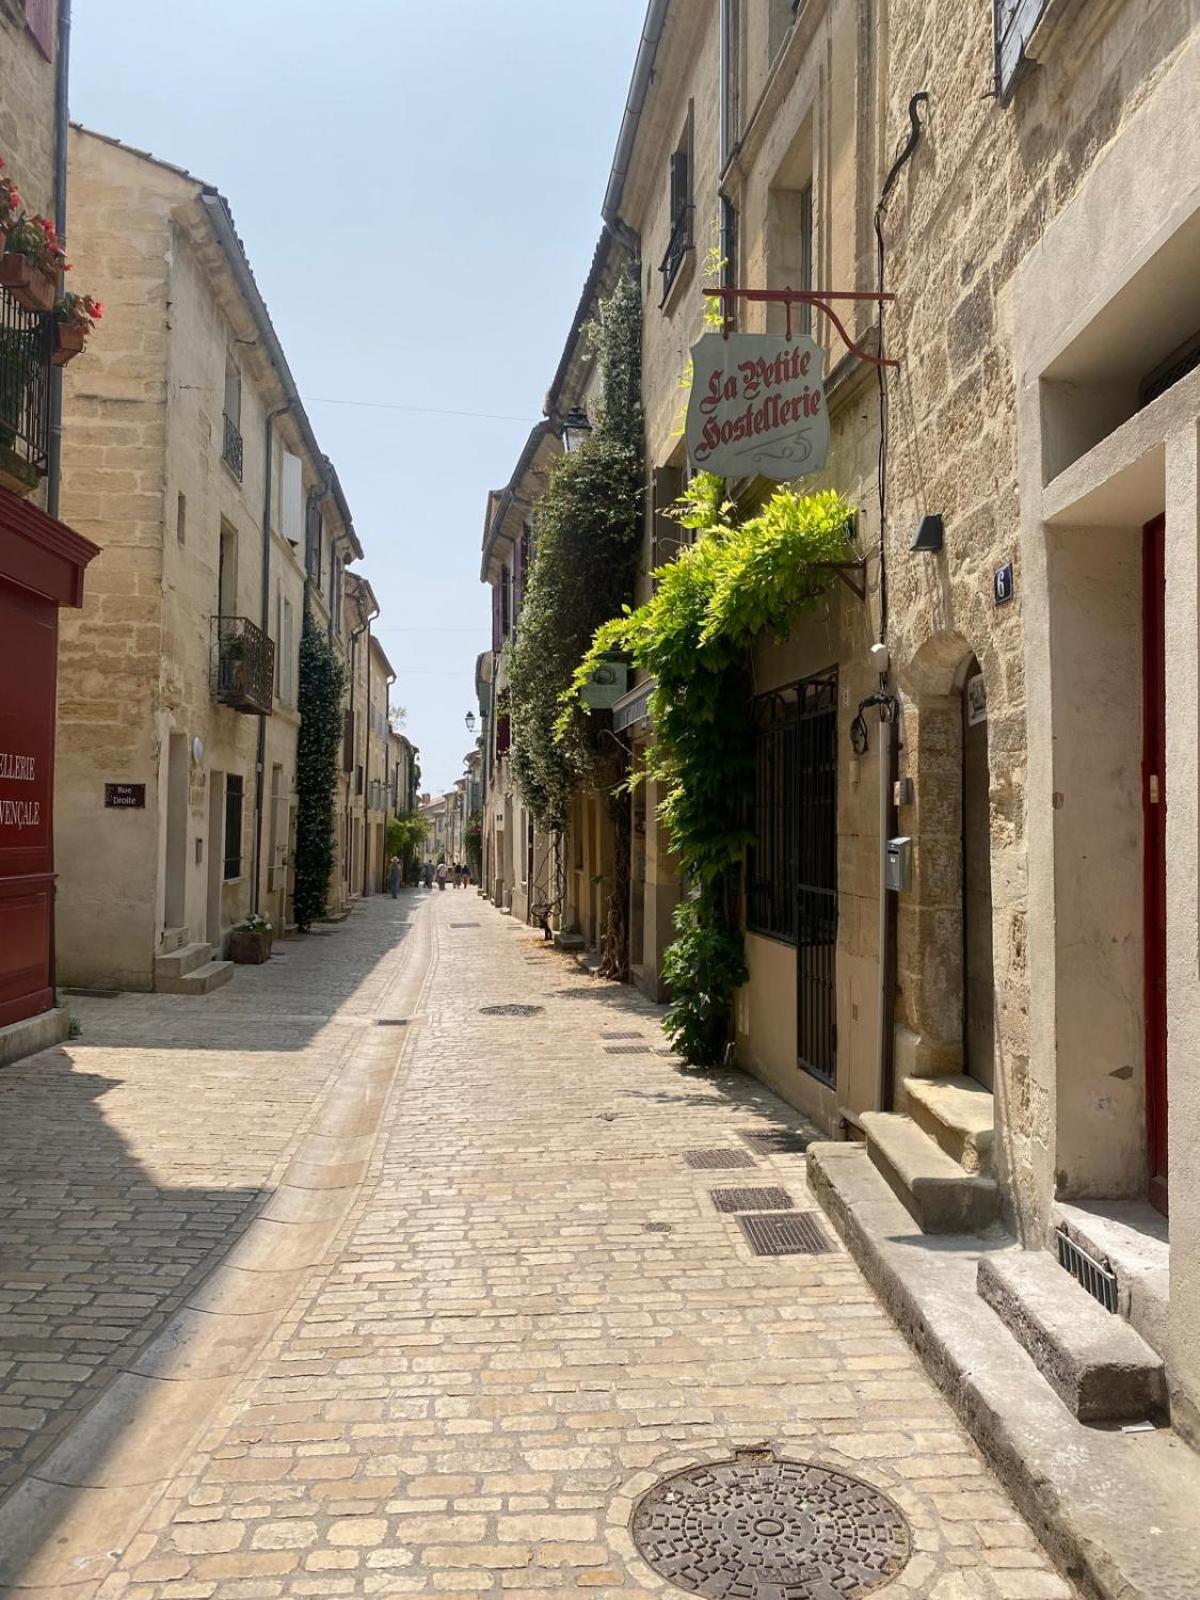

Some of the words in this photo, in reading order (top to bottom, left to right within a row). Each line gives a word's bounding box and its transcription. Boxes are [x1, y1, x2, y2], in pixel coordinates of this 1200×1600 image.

[699, 369, 738, 415] La
[738, 346, 812, 400] Petite
[693, 385, 822, 462] Hostellerie
[996, 570, 1005, 598] 6
[113, 796, 137, 805] Droite
[117, 786, 132, 794] Rue
